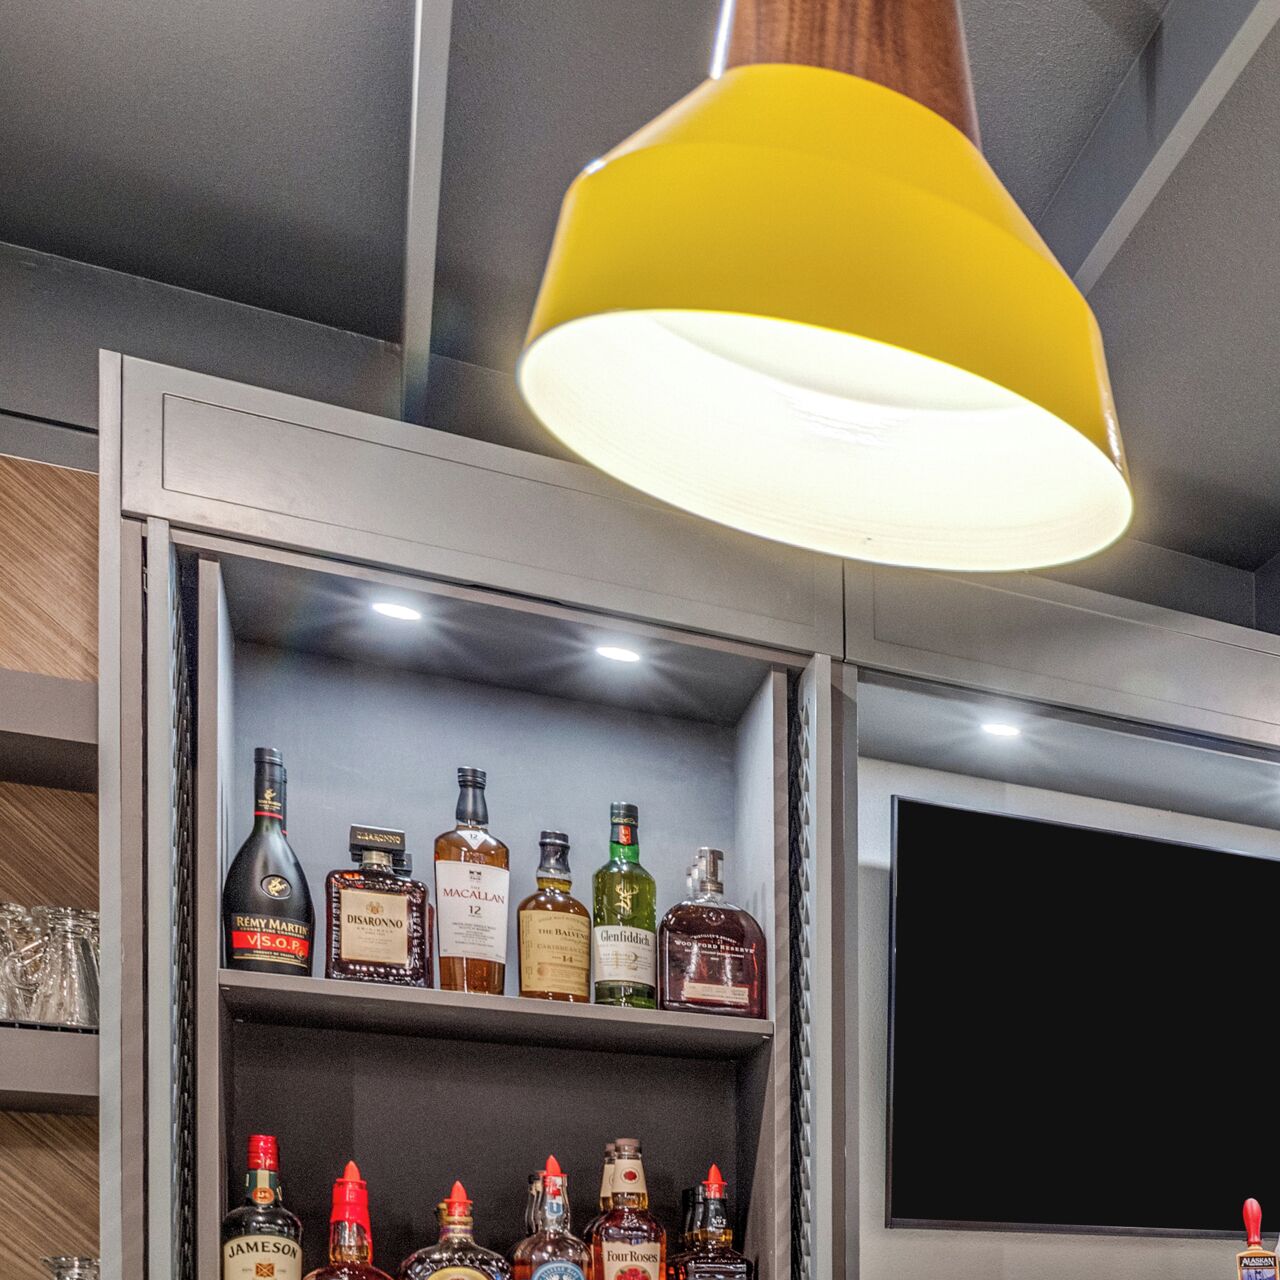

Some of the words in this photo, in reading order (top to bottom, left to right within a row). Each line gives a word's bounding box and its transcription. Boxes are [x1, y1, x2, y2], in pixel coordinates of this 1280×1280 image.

[443, 888, 505, 905] MACALLAN
[468, 905, 481, 915] 12
[236, 915, 267, 928] RÉMY
[269, 918, 308, 936] MARTIN
[347, 914, 403, 929] DISARONNO
[600, 930, 651, 946] Glenfiddich
[228, 1241, 298, 1259] JAMESON
[607, 1249, 629, 1262] Four
[629, 1250, 659, 1263] Roses
[1241, 1257, 1275, 1267] ALASKAN
